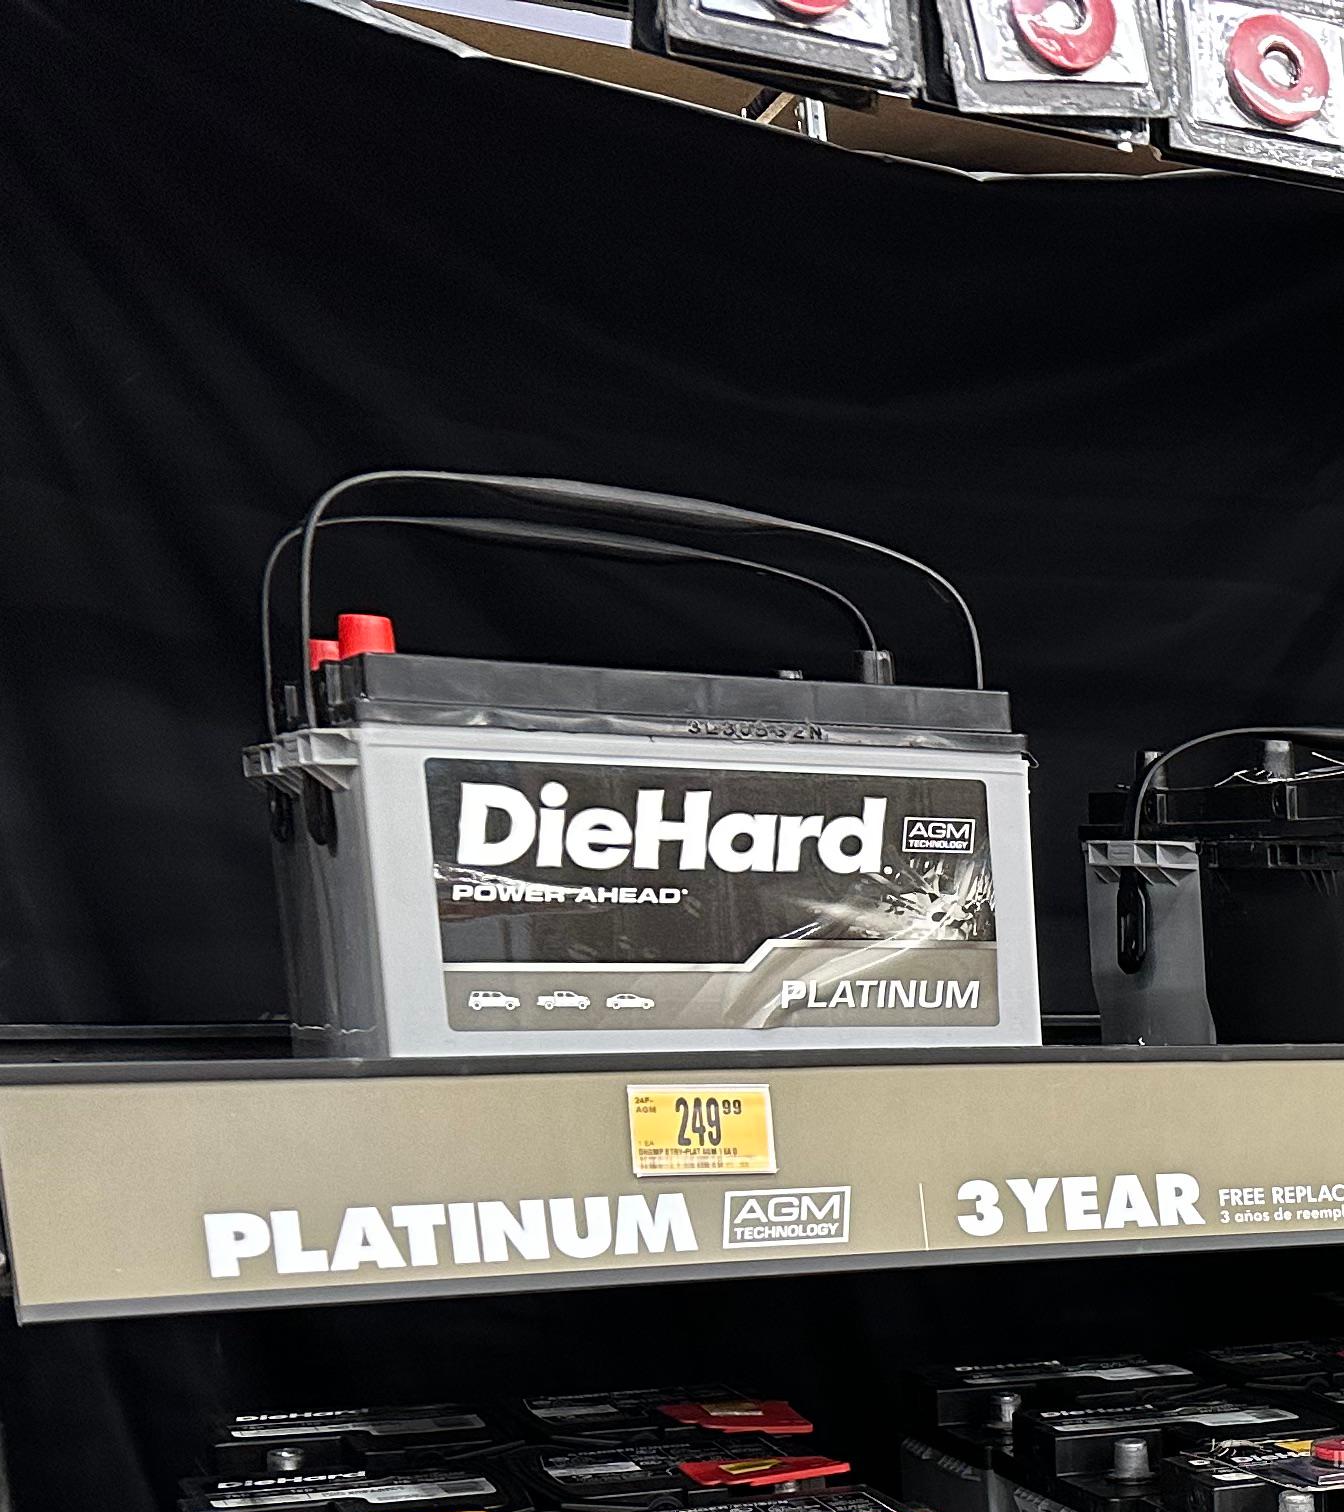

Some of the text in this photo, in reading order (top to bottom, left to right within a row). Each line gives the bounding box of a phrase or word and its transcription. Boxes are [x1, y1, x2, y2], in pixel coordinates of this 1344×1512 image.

[457, 781, 889, 876] DieHard
[909, 821, 971, 841] AGM
[907, 840, 969, 851] TECHNOLOGY
[452, 884, 682, 905] POWER AHEAD
[781, 980, 981, 1011] PLATINUM
[957, 1173, 1206, 1237] 3 YEAR
[1219, 1187, 1266, 1206] FREE
[734, 1195, 841, 1224] AGM
[1220, 1210, 1230, 1224] 3
[1234, 1208, 1269, 1224] años
[1273, 1207, 1292, 1223] de
[203, 1192, 698, 1279] PLATINUM
[734, 1223, 839, 1240] TECHNOLOGY
